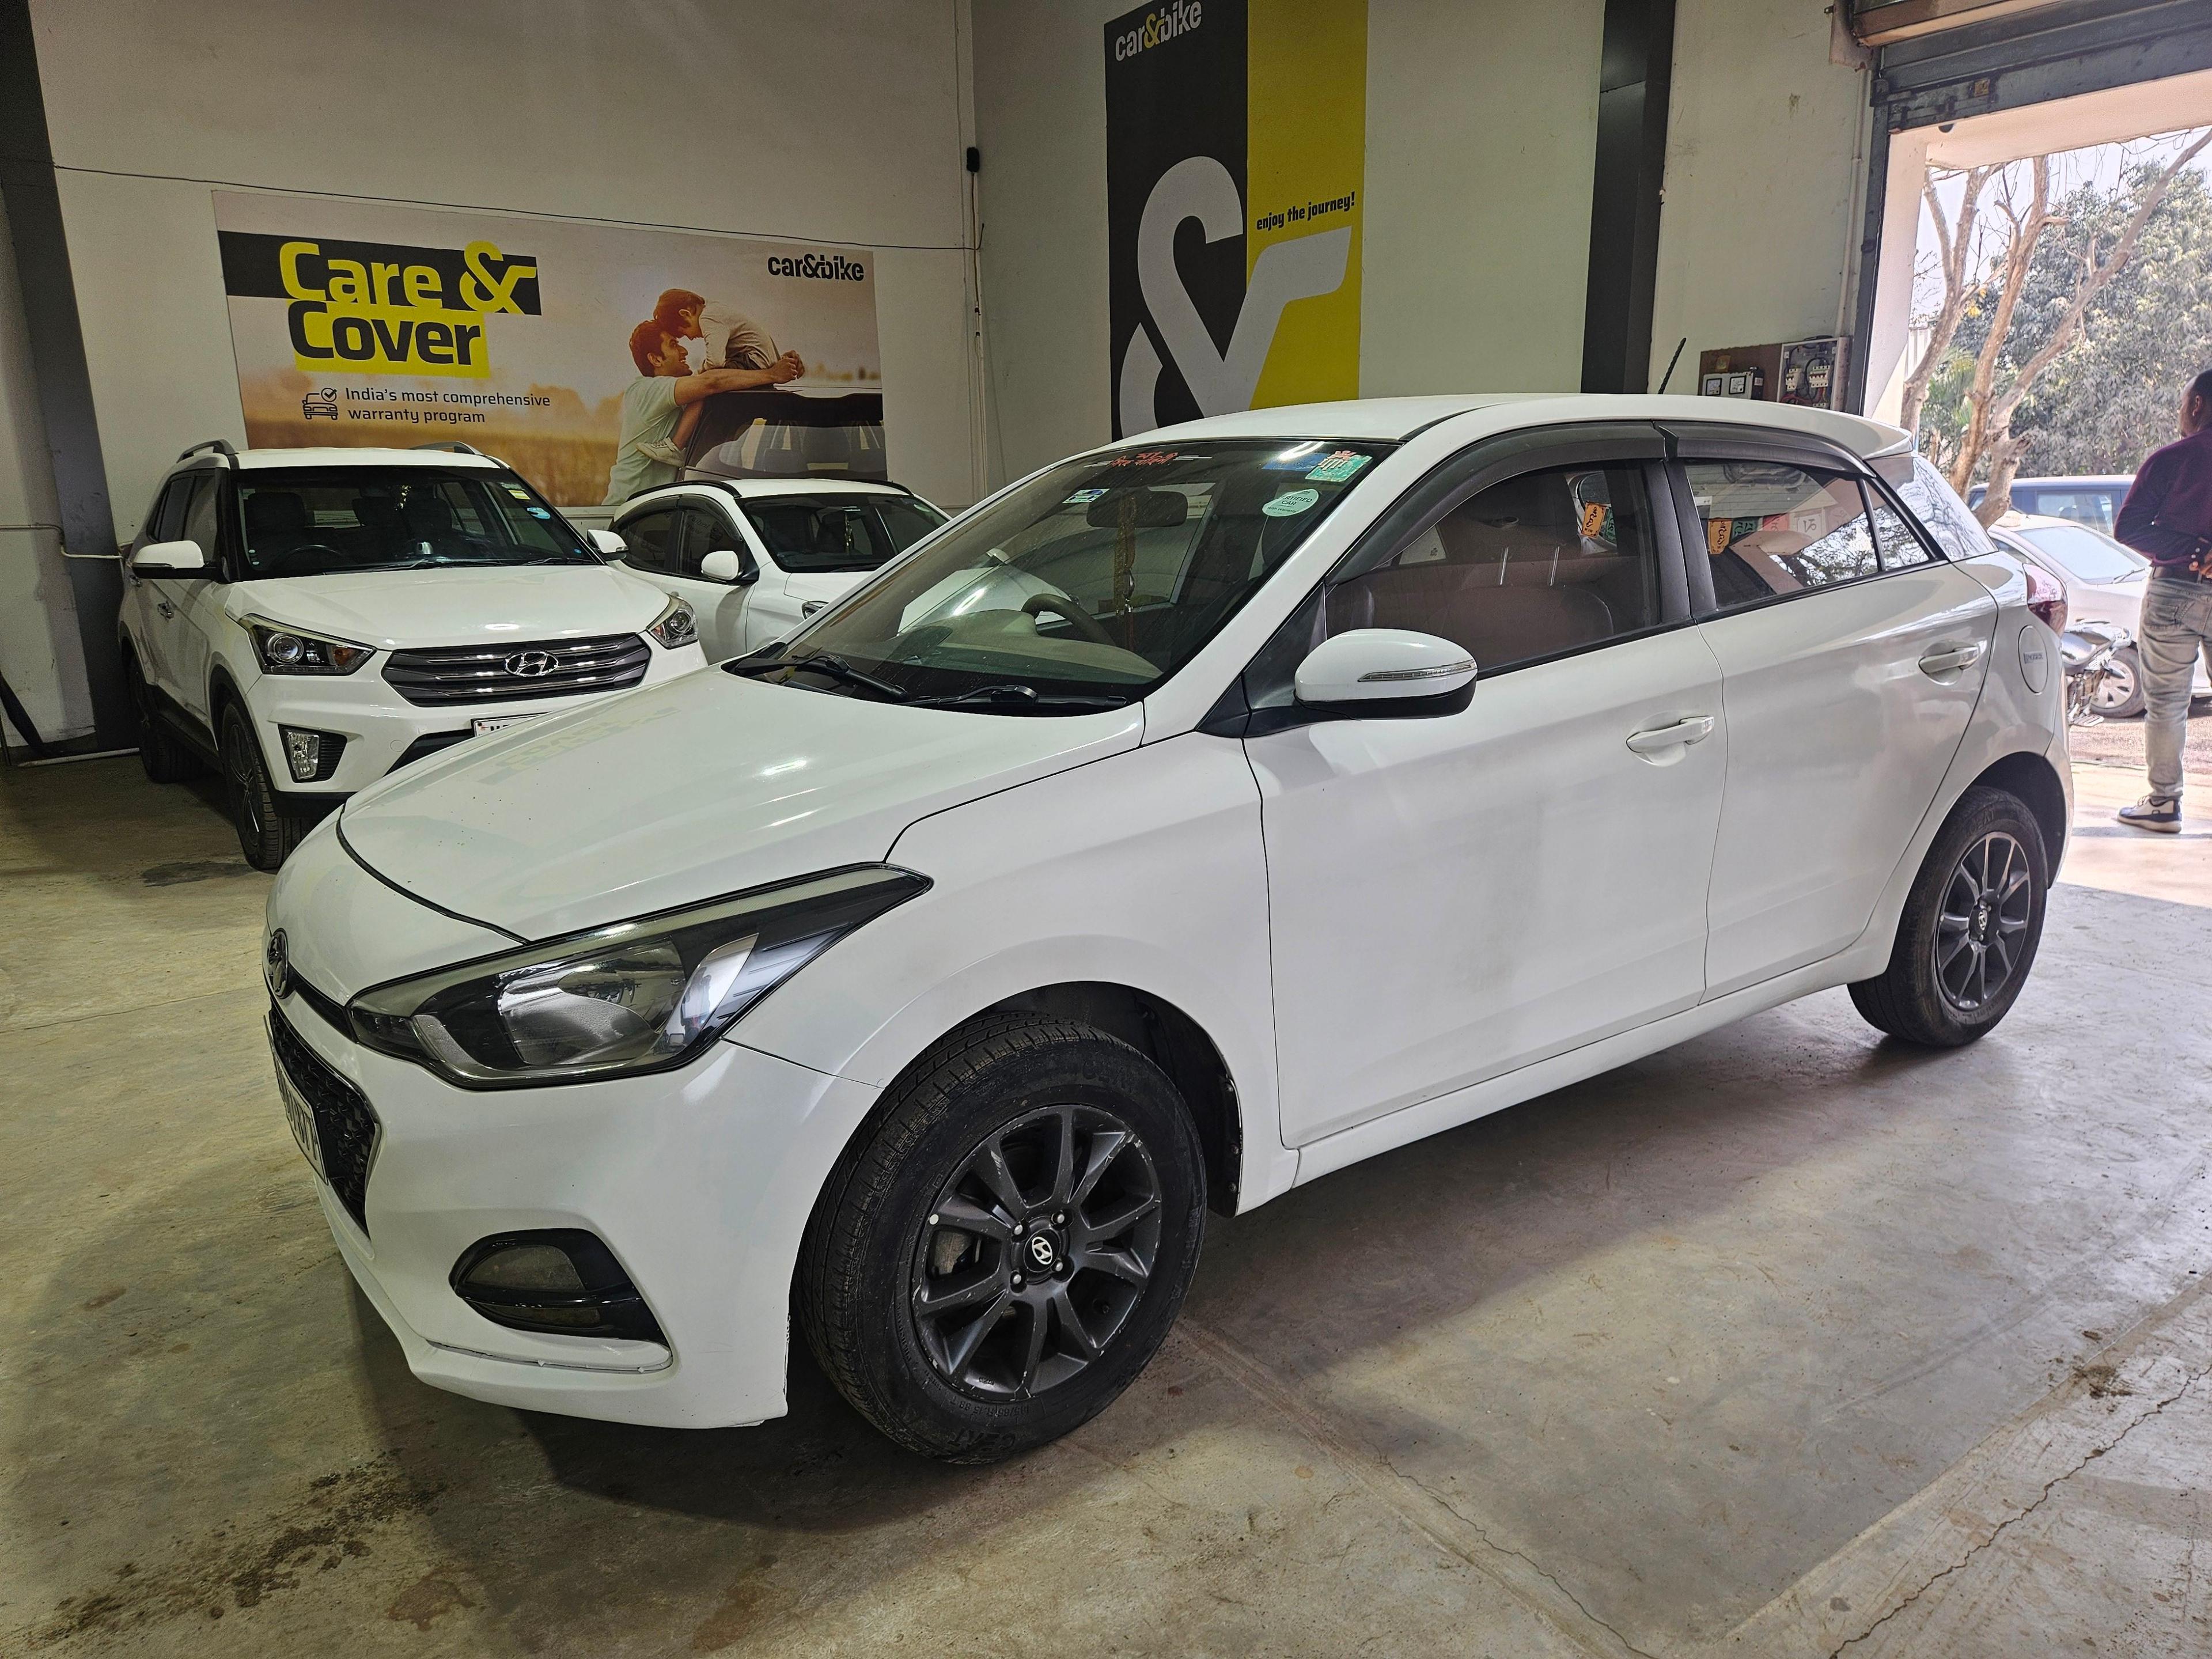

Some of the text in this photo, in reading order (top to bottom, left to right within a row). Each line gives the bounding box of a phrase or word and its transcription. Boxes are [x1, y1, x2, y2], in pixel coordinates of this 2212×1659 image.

[1115, 0, 1202, 62] car&bike
[1256, 191, 1356, 231] enjoy the journey!
[279, 240, 537, 315] Care &
[767, 253, 864, 281] car&bike
[287, 300, 481, 365] Cover
[346, 387, 551, 407] India's most comprehensive
[348, 408, 486, 425] warranty program
